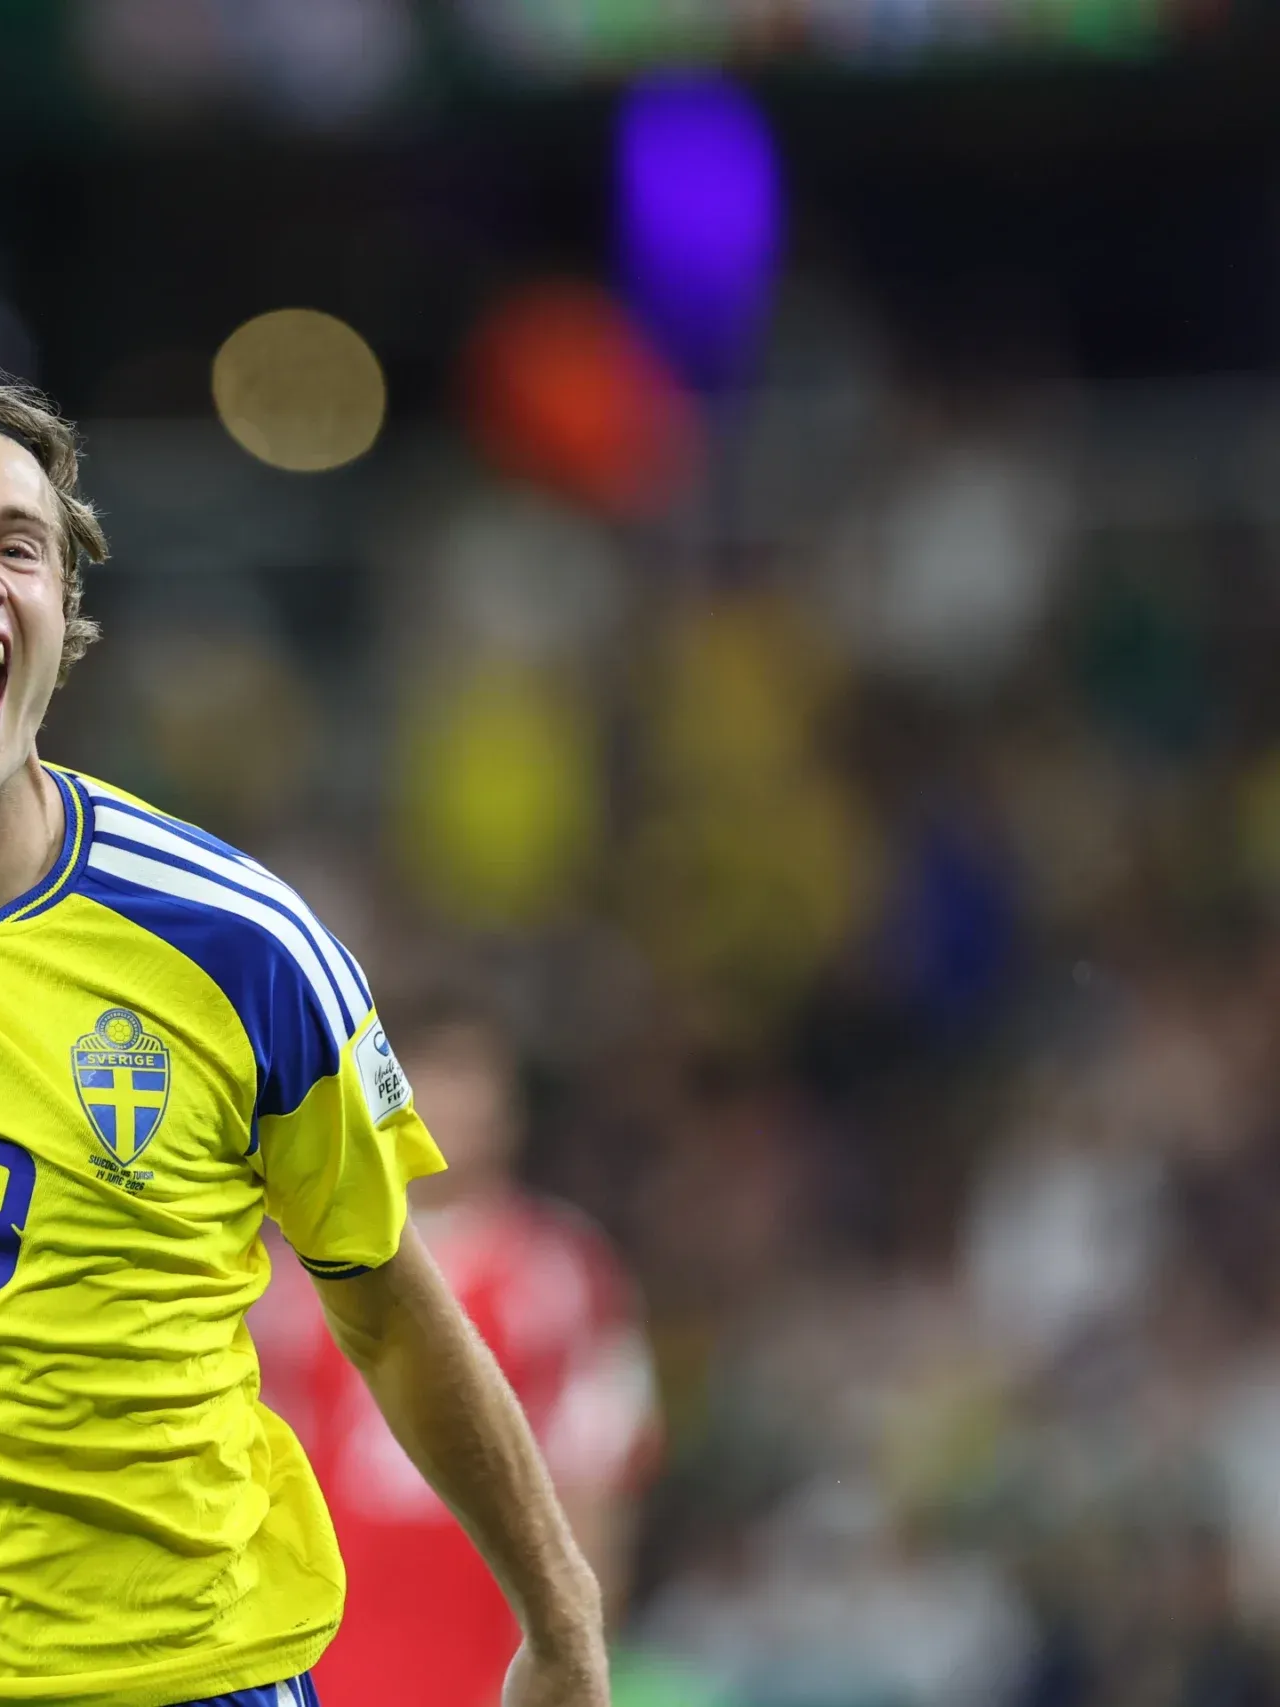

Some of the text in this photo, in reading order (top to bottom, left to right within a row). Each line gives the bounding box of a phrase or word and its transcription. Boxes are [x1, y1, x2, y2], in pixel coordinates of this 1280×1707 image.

[87, 1054, 155, 1067] SVERIGE
[378, 1073, 402, 1099] PEA
[88, 1154, 120, 1173] SWEDEN
[125, 1179, 146, 1191] 2026
